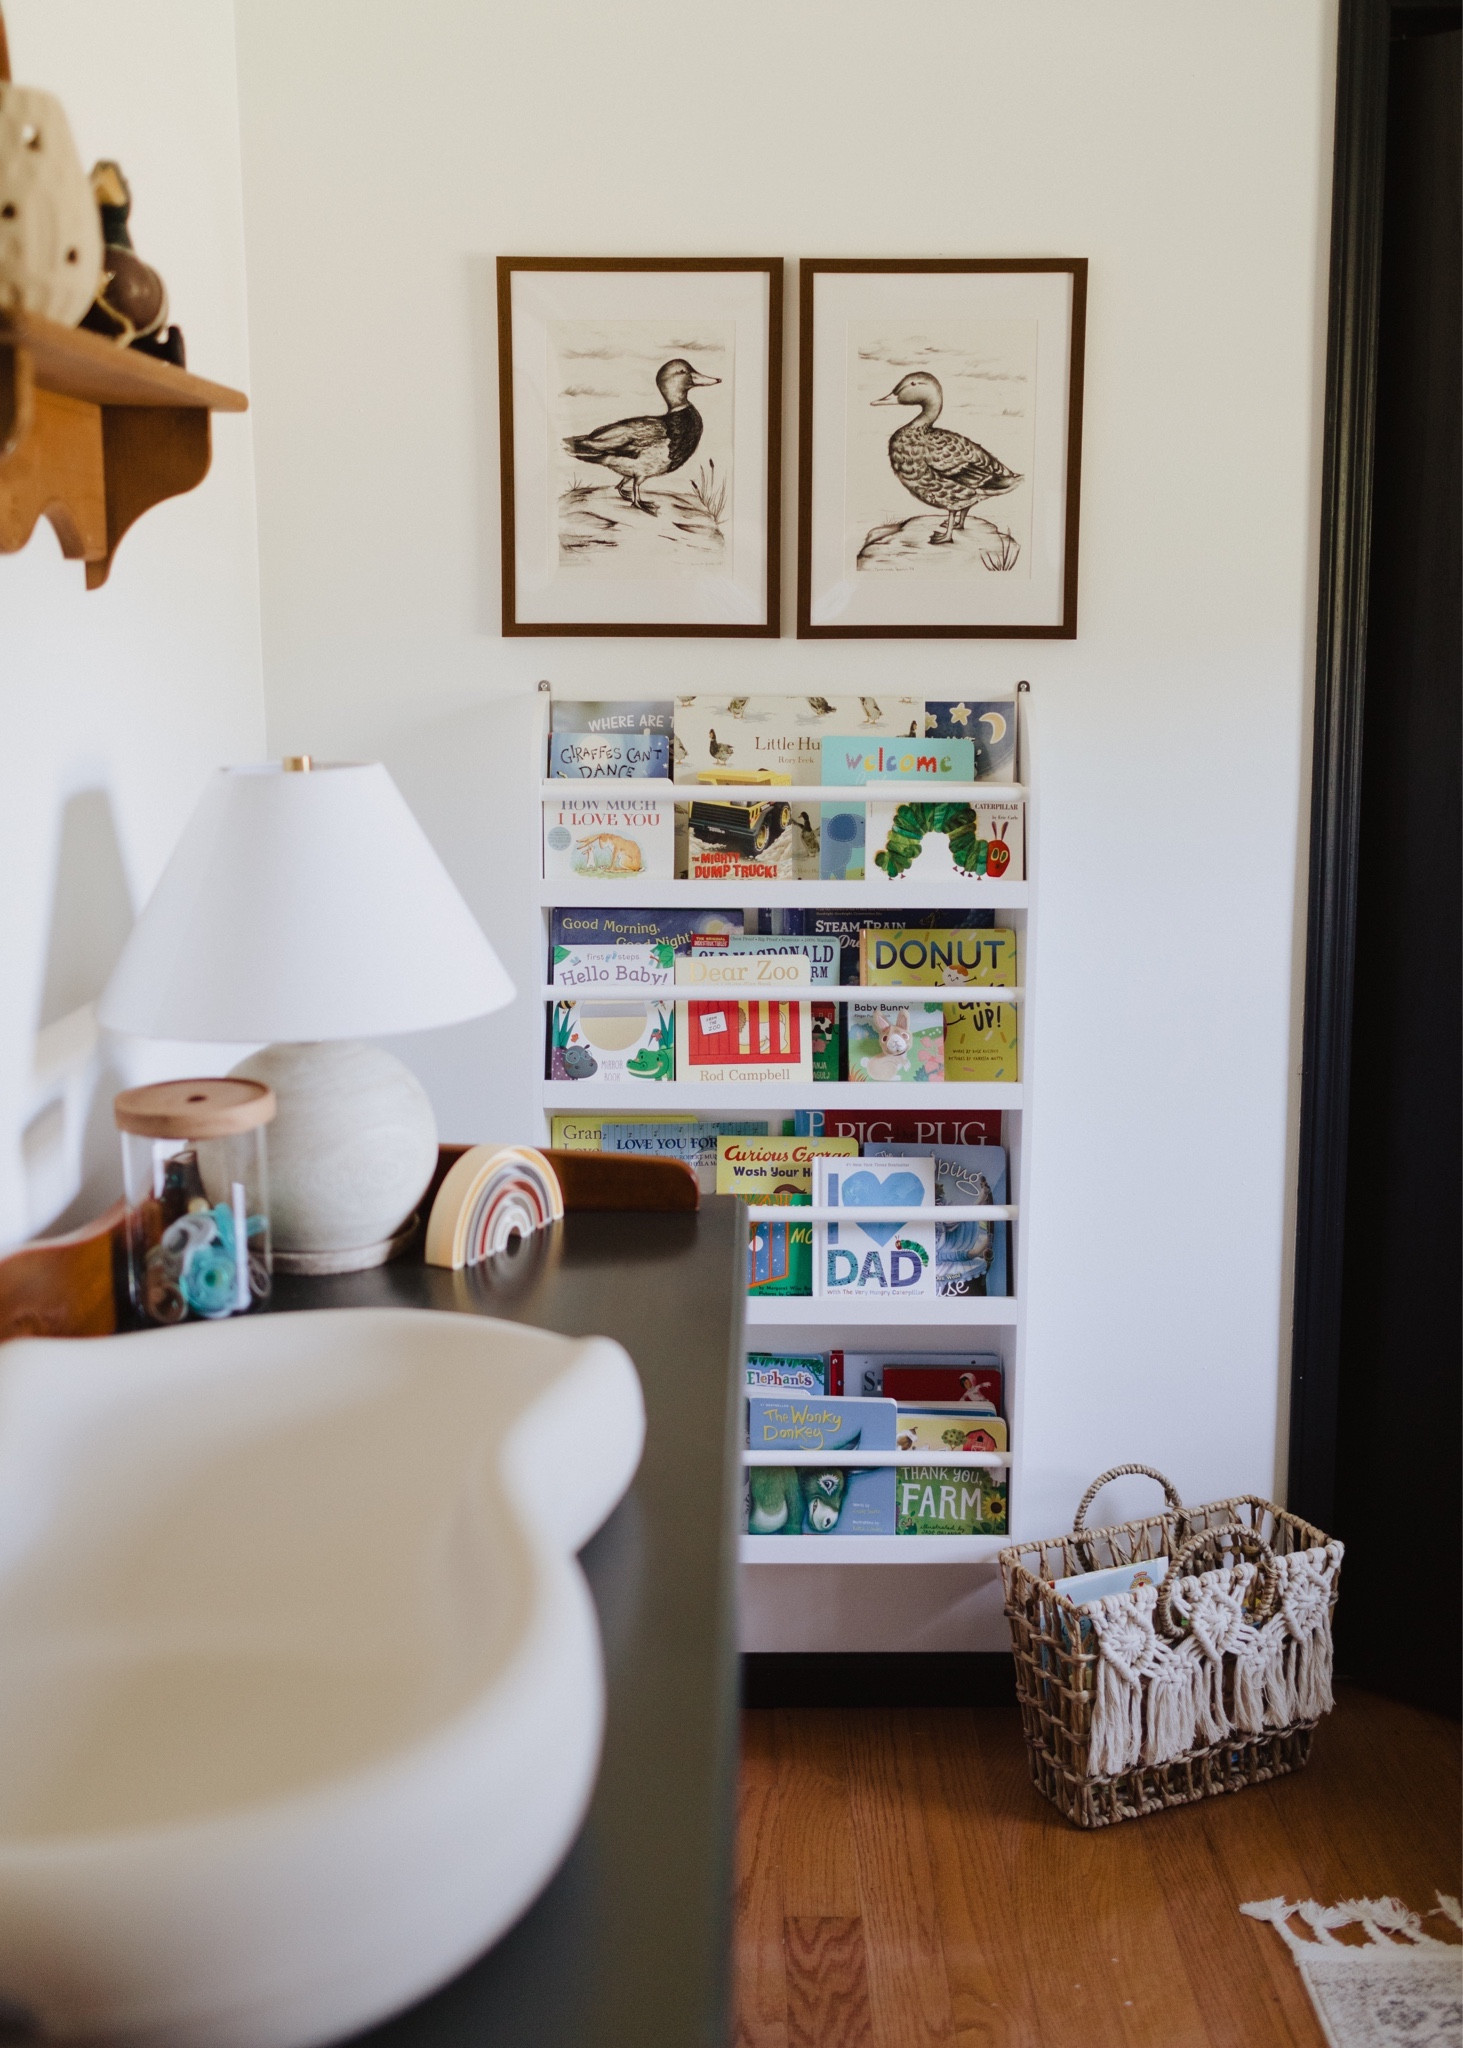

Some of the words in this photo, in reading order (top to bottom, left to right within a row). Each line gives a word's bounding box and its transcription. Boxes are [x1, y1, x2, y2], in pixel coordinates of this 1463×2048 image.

[588, 714, 635, 732] WHERE
[640, 714, 664, 727] ARE
[755, 736, 795, 750] Little
[560, 745, 621, 764] GIRAFFES
[626, 747, 662, 764] CAN'T
[845, 747, 953, 773] welcome
[579, 763, 635, 779] DANCE
[561, 800, 599, 811] HOW
[606, 800, 656, 811] MUCH
[558, 813, 564, 825] I
[571, 813, 618, 825] LOVE
[623, 813, 660, 826] YOU
[700, 852, 740, 864] MIGHTY
[694, 865, 731, 879] DUMP
[733, 864, 777, 879] TRUCK!
[562, 918, 599, 930] Good
[603, 919, 661, 936] Morning,
[815, 920, 860, 933] STEAM
[863, 920, 906, 929] TRAIN
[876, 940, 1005, 969] DONUT
[560, 966, 609, 986] Hello
[615, 965, 668, 986] Baby!
[690, 961, 748, 982] Dear
[757, 960, 799, 980] Zoo
[854, 1003, 878, 1013] Baby
[880, 1003, 910, 1012] Bunny
[973, 1005, 1001, 1032] UP!
[604, 1072, 621, 1082] BOOK
[700, 1070, 724, 1081] Rod
[729, 1068, 790, 1082] Campbell
[914, 1121, 988, 1146] PUG
[616, 1138, 652, 1150] LOVE
[656, 1138, 687, 1149] YOU
[724, 1145, 789, 1162] Curious
[733, 1166, 767, 1177] Wash
[771, 1167, 800, 1178] Your
[827, 1250, 922, 1288] DAD
[763, 1409, 788, 1423] The
[790, 1405, 842, 1432] Wonky
[763, 1425, 824, 1450] Donkey
[901, 1467, 949, 1480] THANK
[953, 1468, 982, 1485] YOU,
[901, 1483, 983, 1520] FARM
